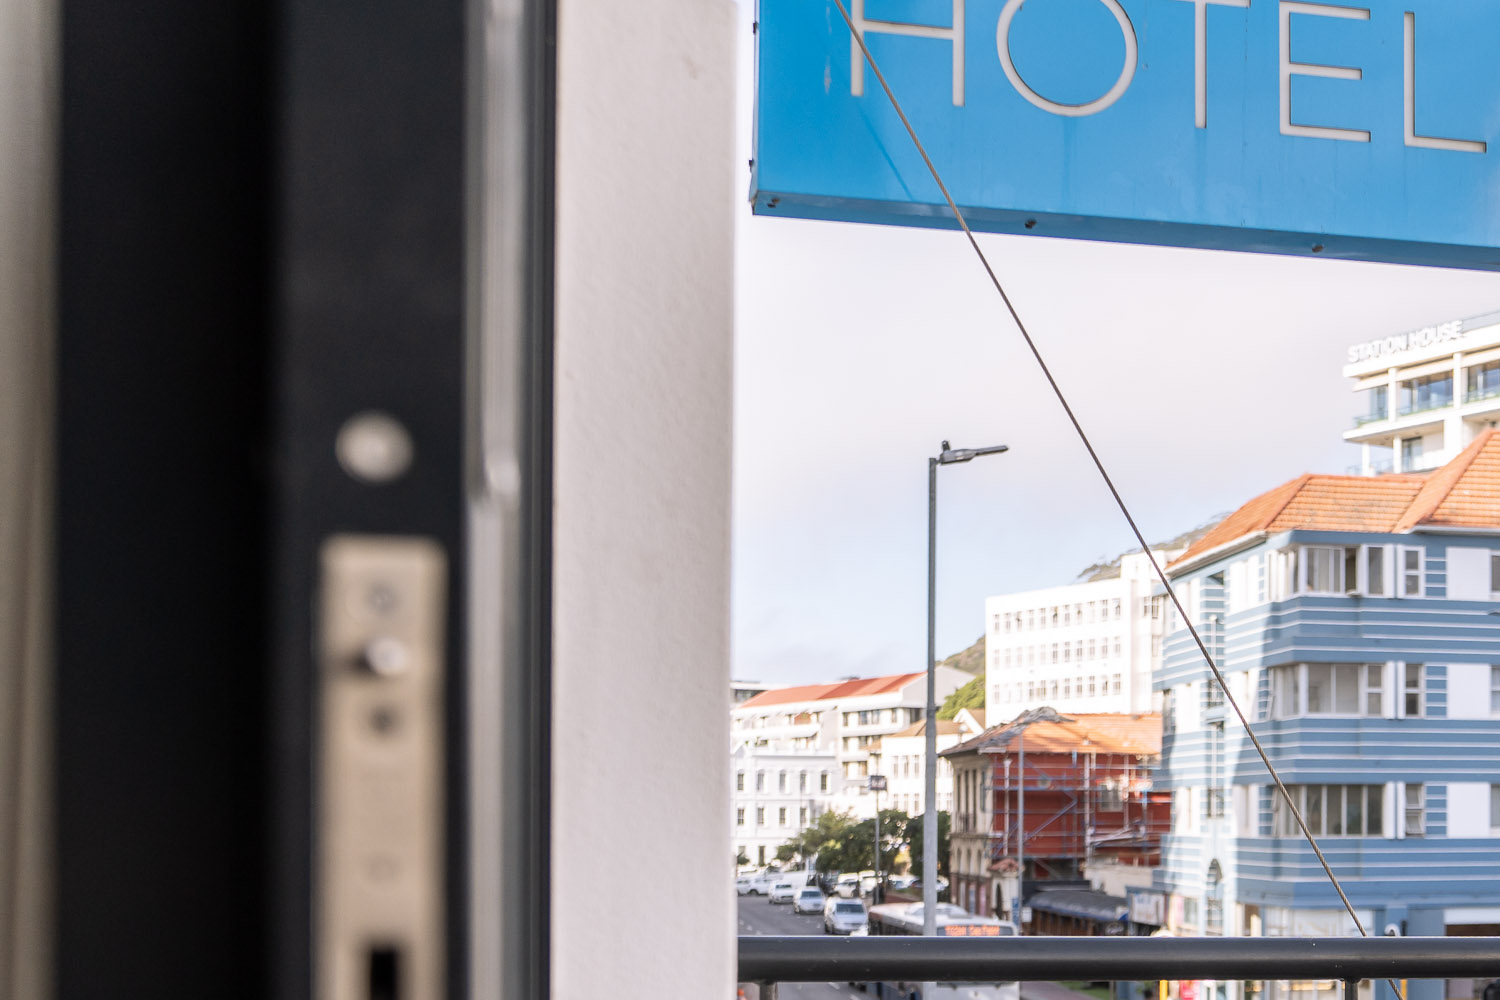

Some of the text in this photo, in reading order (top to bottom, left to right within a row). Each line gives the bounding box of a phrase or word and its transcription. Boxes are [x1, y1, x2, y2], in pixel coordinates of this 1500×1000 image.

[850, 0, 1488, 154] HOTEL
[1347, 319, 1463, 363] STATION HOUSE
